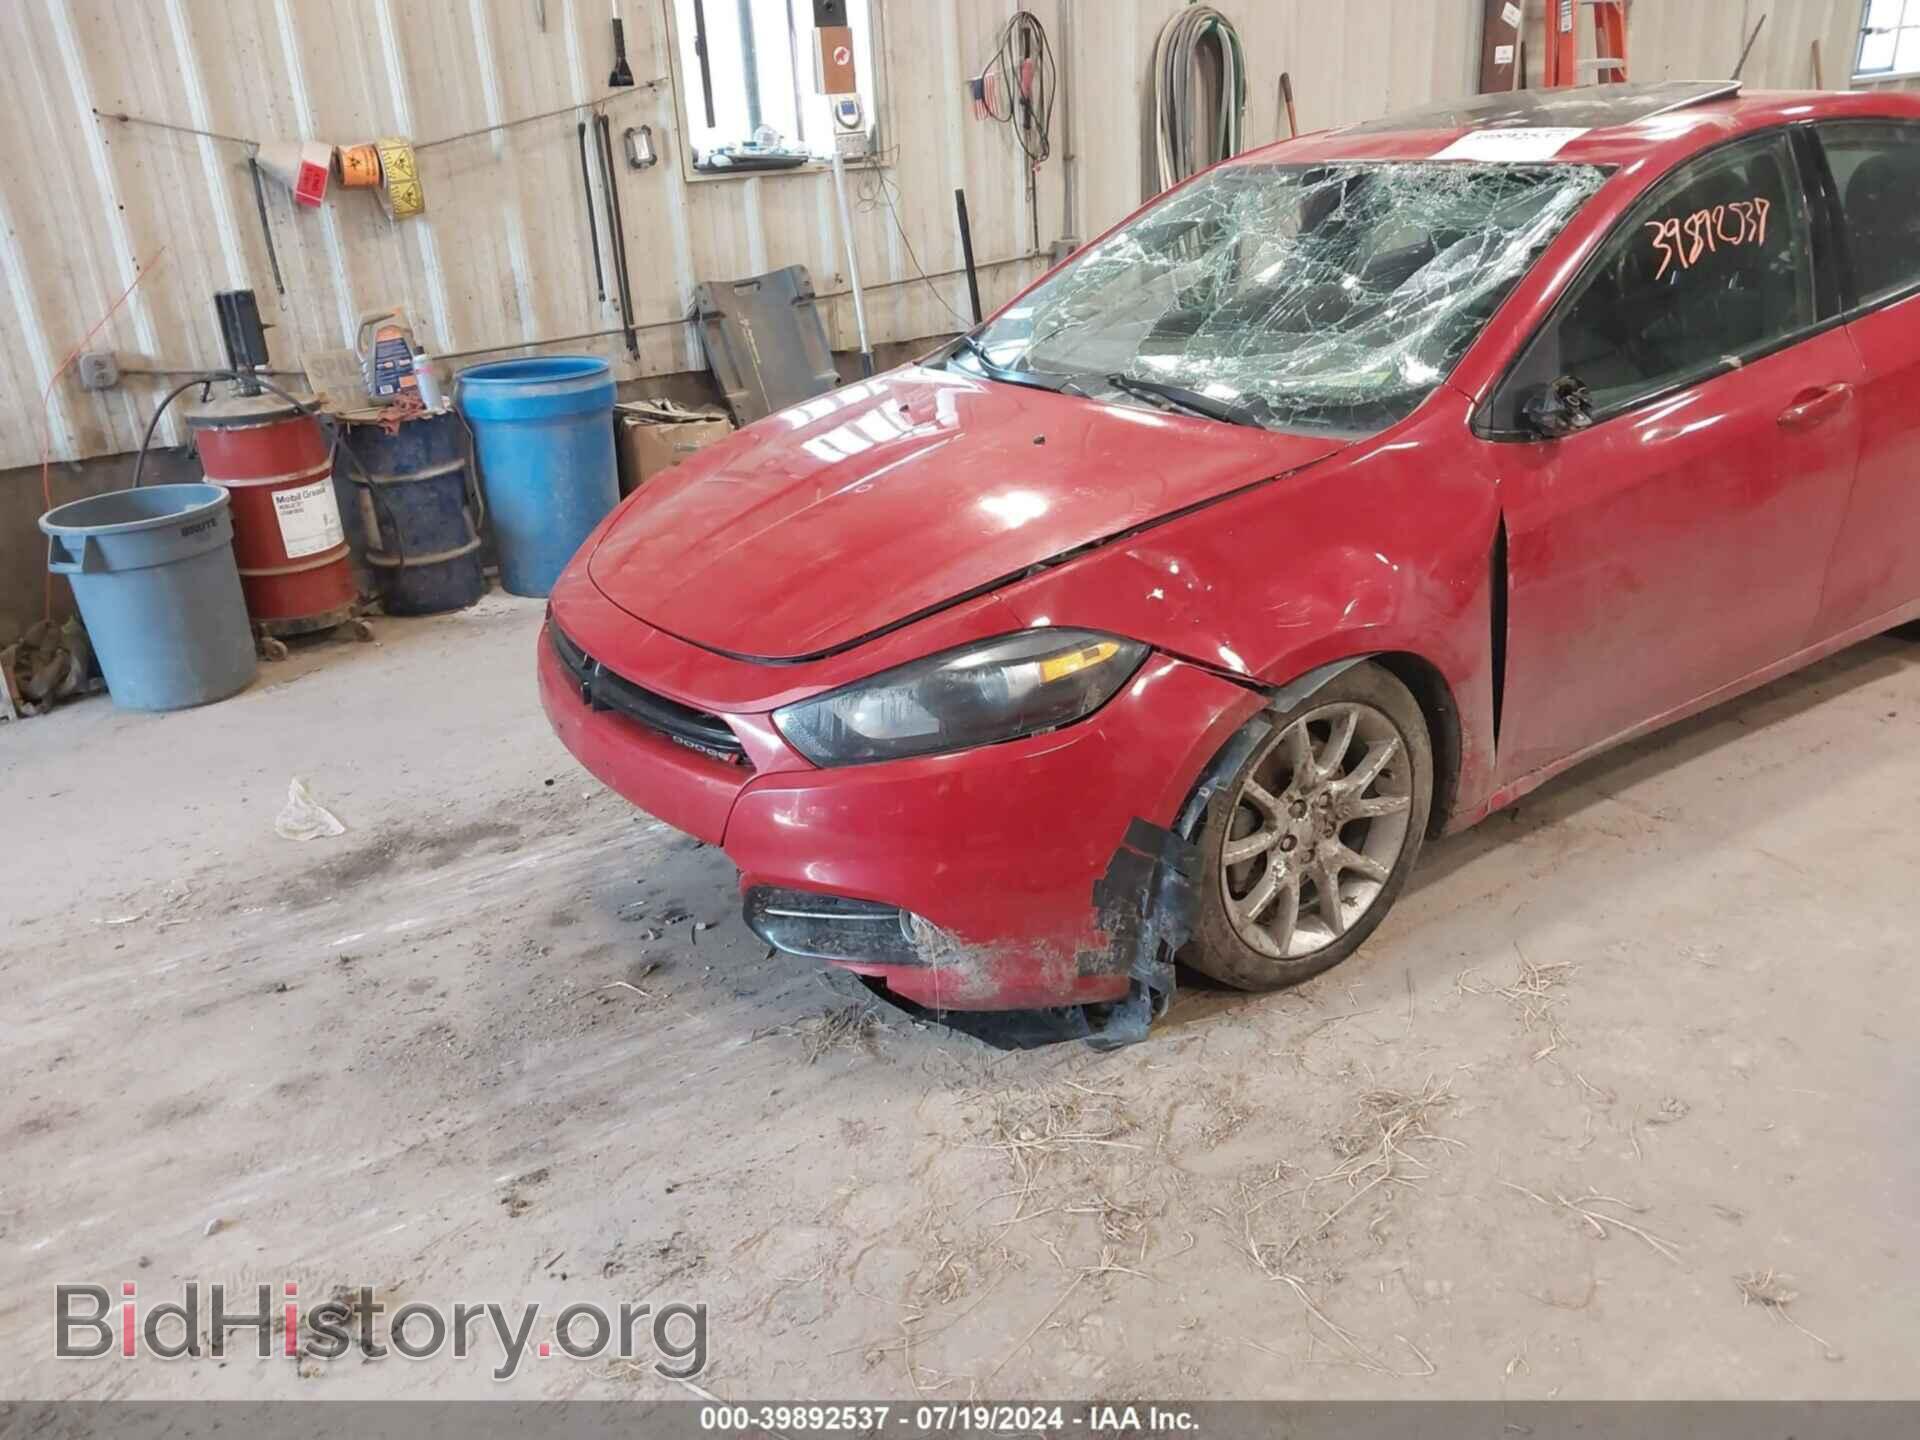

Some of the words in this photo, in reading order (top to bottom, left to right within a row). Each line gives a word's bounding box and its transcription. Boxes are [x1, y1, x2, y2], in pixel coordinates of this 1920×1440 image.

[1644, 197, 1770, 280] 39892537
[311, 357, 361, 378] SPIL
[672, 735, 730, 761] DODGE
